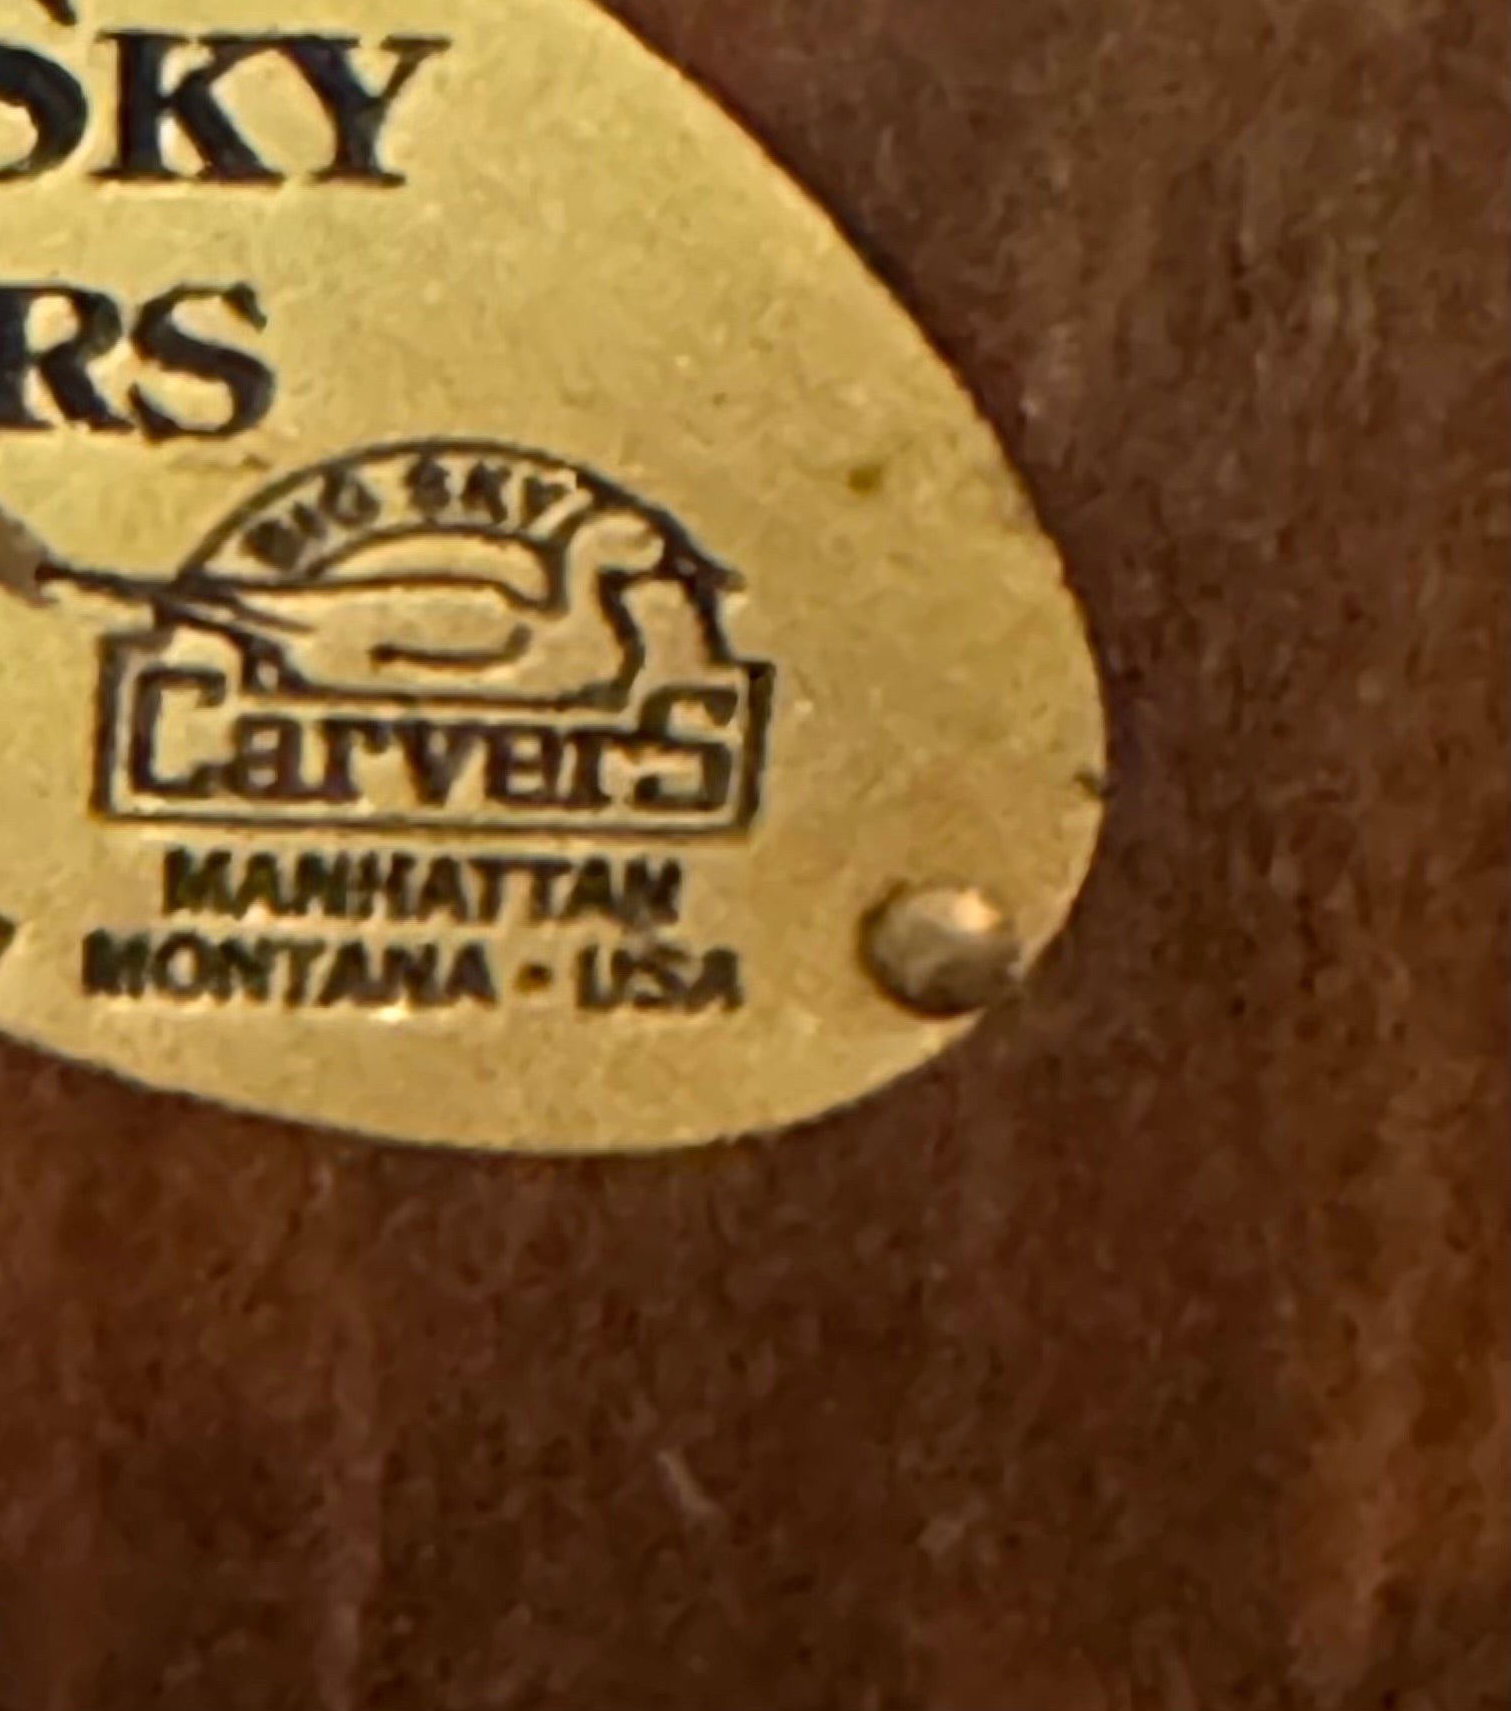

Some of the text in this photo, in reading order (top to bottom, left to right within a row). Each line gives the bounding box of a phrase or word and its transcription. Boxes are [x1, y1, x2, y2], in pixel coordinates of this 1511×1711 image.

[244, 453, 588, 572] BIG SKY
[162, 847, 684, 925] MANHATTAN
[82, 927, 498, 1009] MONTANA
[574, 935, 746, 1012] USA
